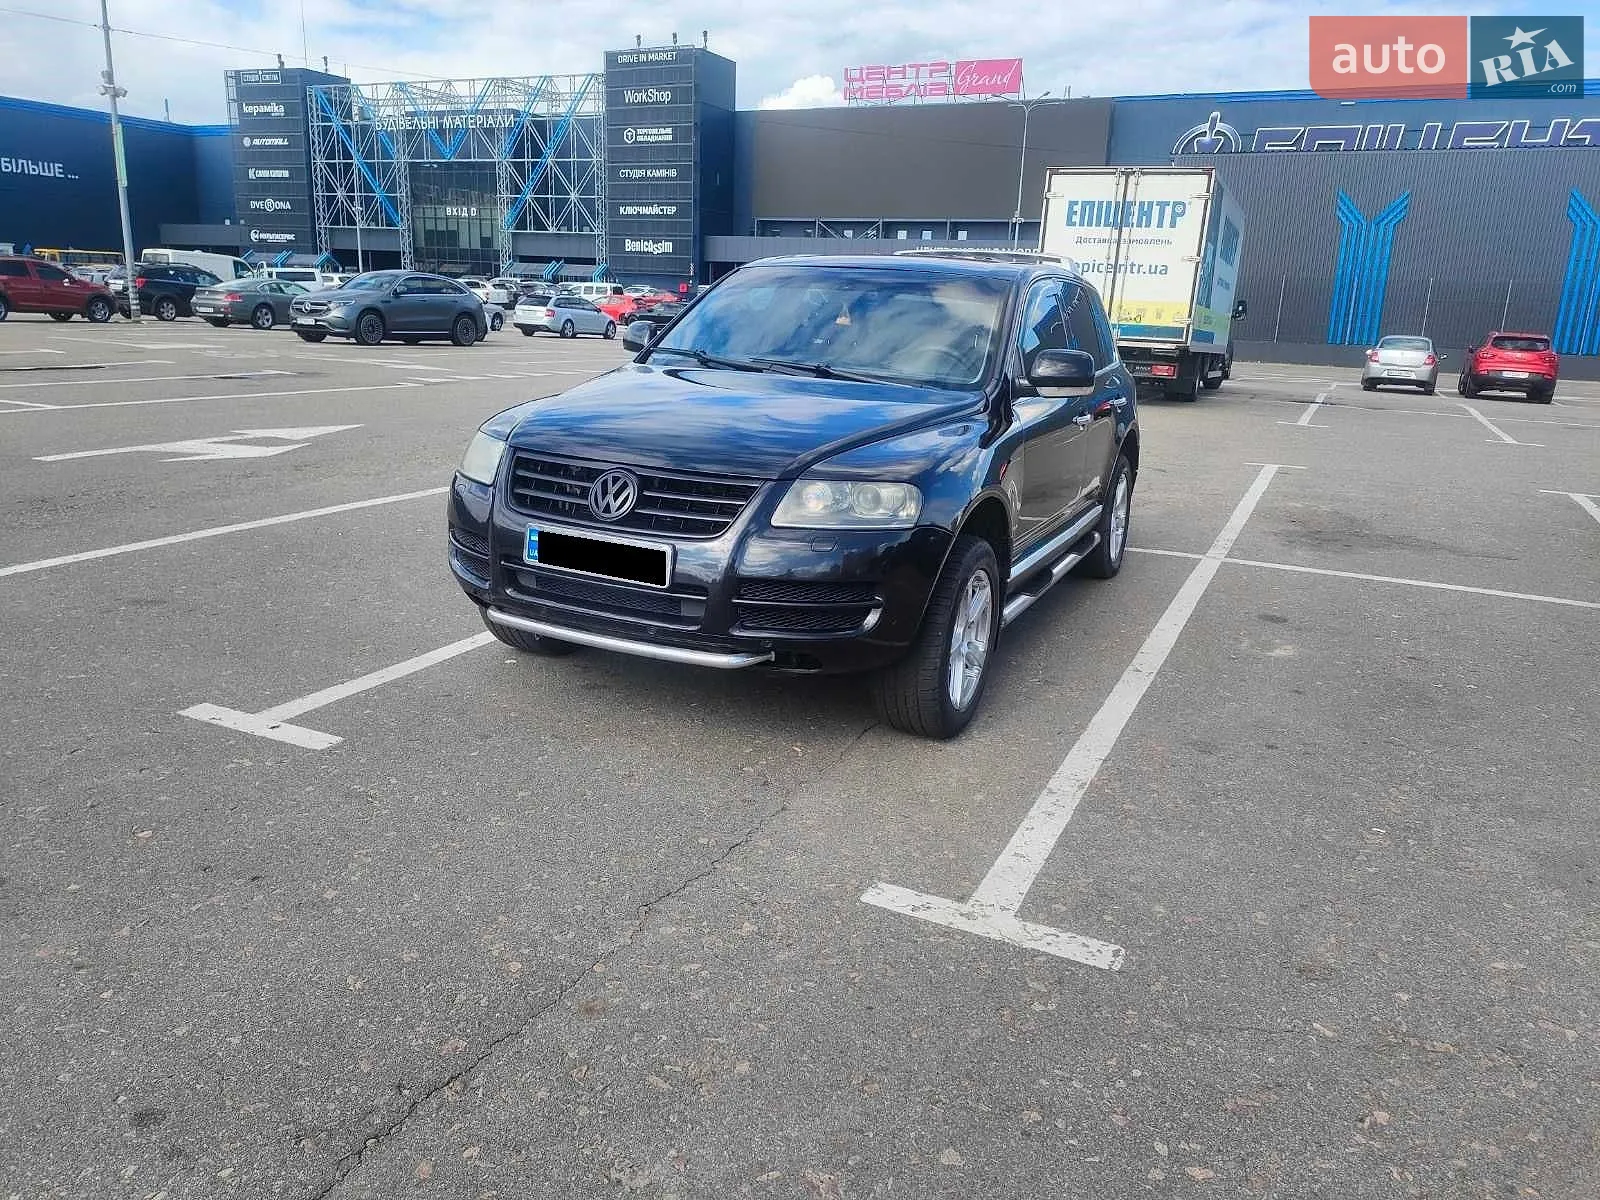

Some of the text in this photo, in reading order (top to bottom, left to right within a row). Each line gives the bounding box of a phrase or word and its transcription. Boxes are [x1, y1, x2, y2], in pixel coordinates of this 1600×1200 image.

[618, 51, 677, 64] DRIVE IN MARKET
[957, 58, 1020, 94] Grand
[624, 88, 672, 104] WorkShop
[375, 113, 515, 132] БУДІВЕЛЬНІ МАТЕРІАЛИ
[619, 168, 677, 179] СТУДІЯ КАМІНІВ
[446, 206, 469, 217] ВХІД
[619, 204, 677, 215] КЛЮЧМАЙСТЕР
[1065, 200, 1186, 230] ЕПІЦЕНТР
[1075, 235, 1119, 246] Доставка
